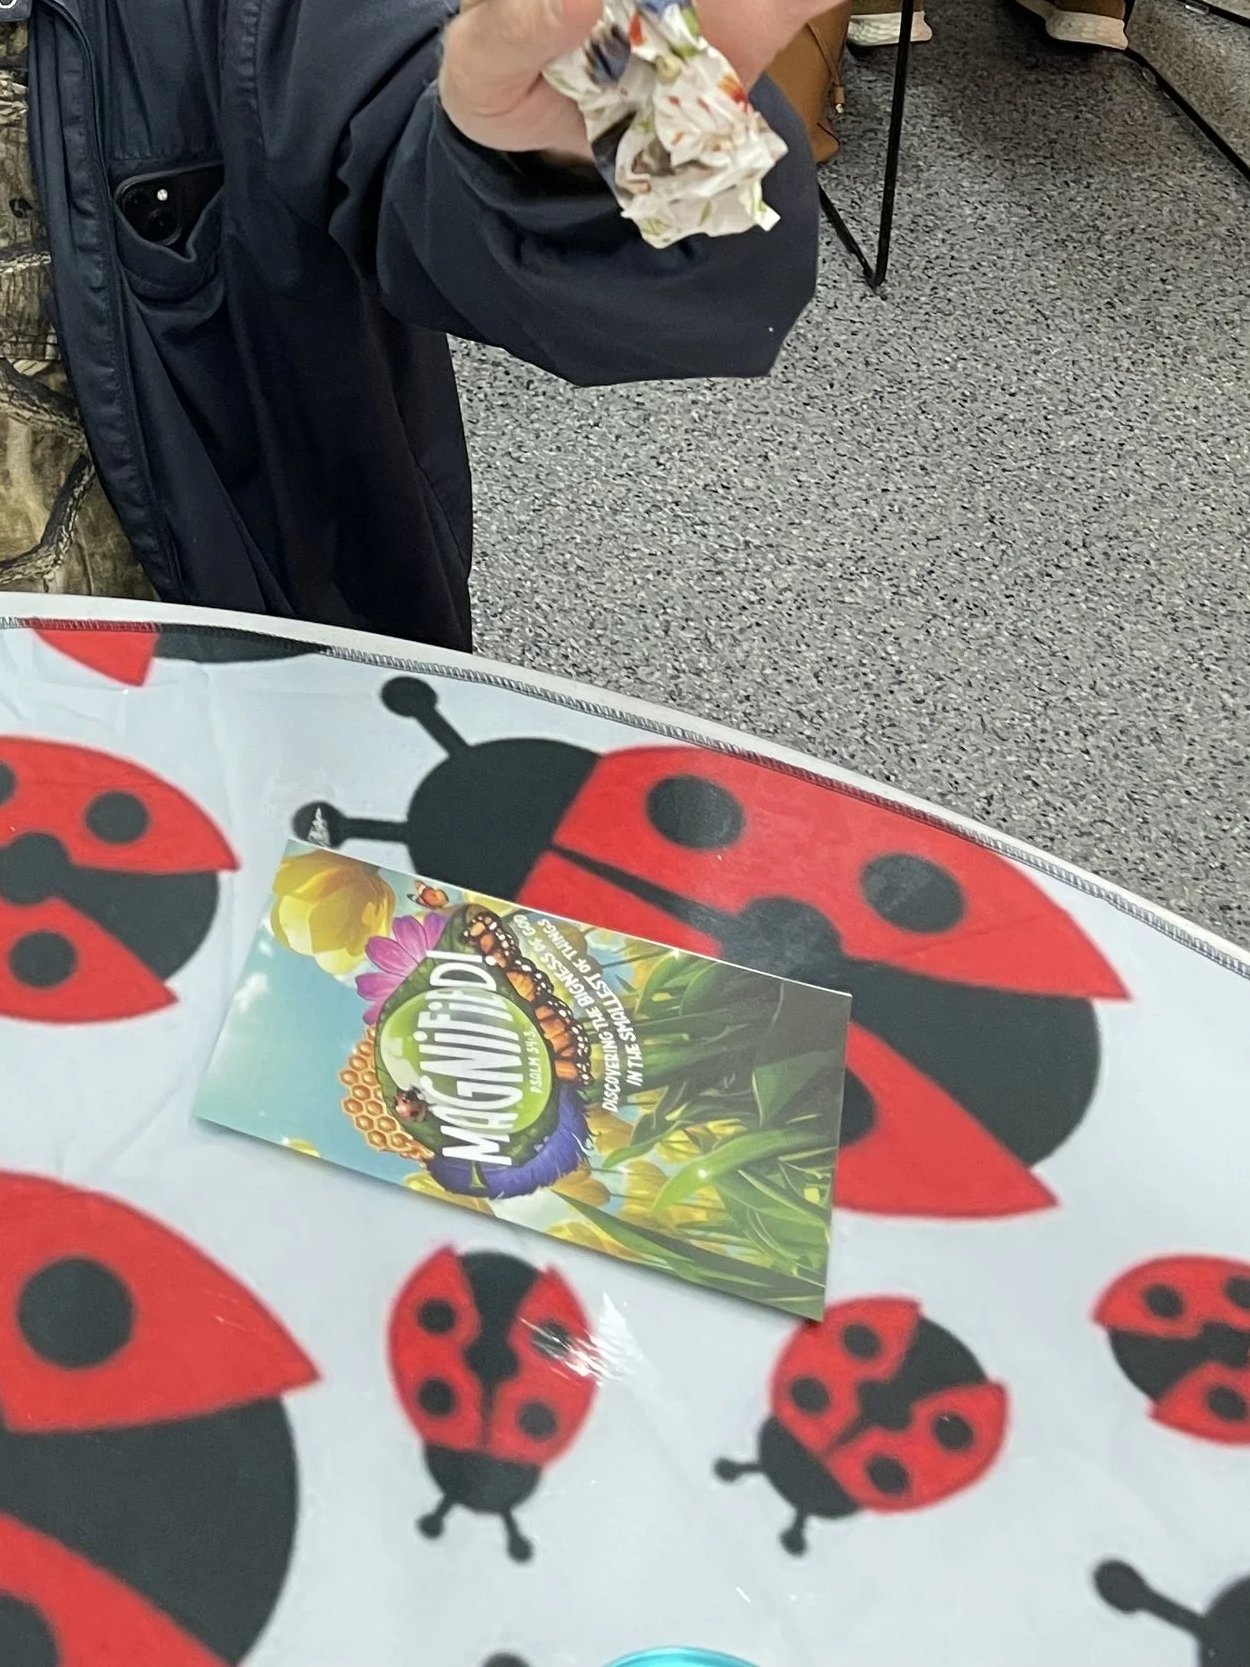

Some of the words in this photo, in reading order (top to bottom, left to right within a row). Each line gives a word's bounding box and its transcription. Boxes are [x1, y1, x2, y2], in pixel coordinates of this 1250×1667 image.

[513, 914, 536, 936] GOD
[528, 938, 546, 953] OF
[537, 918, 579, 961] THINGS
[572, 957, 591, 974] OF
[540, 951, 595, 1008] BIGNESS
[584, 972, 637, 1043] SMALLEST
[585, 1006, 609, 1032] THE
[624, 1042, 644, 1069] THE
[528, 1056, 543, 1095] PSALM
[599, 1032, 621, 1113] DISCOVERING
[625, 1068, 643, 1087] IN
